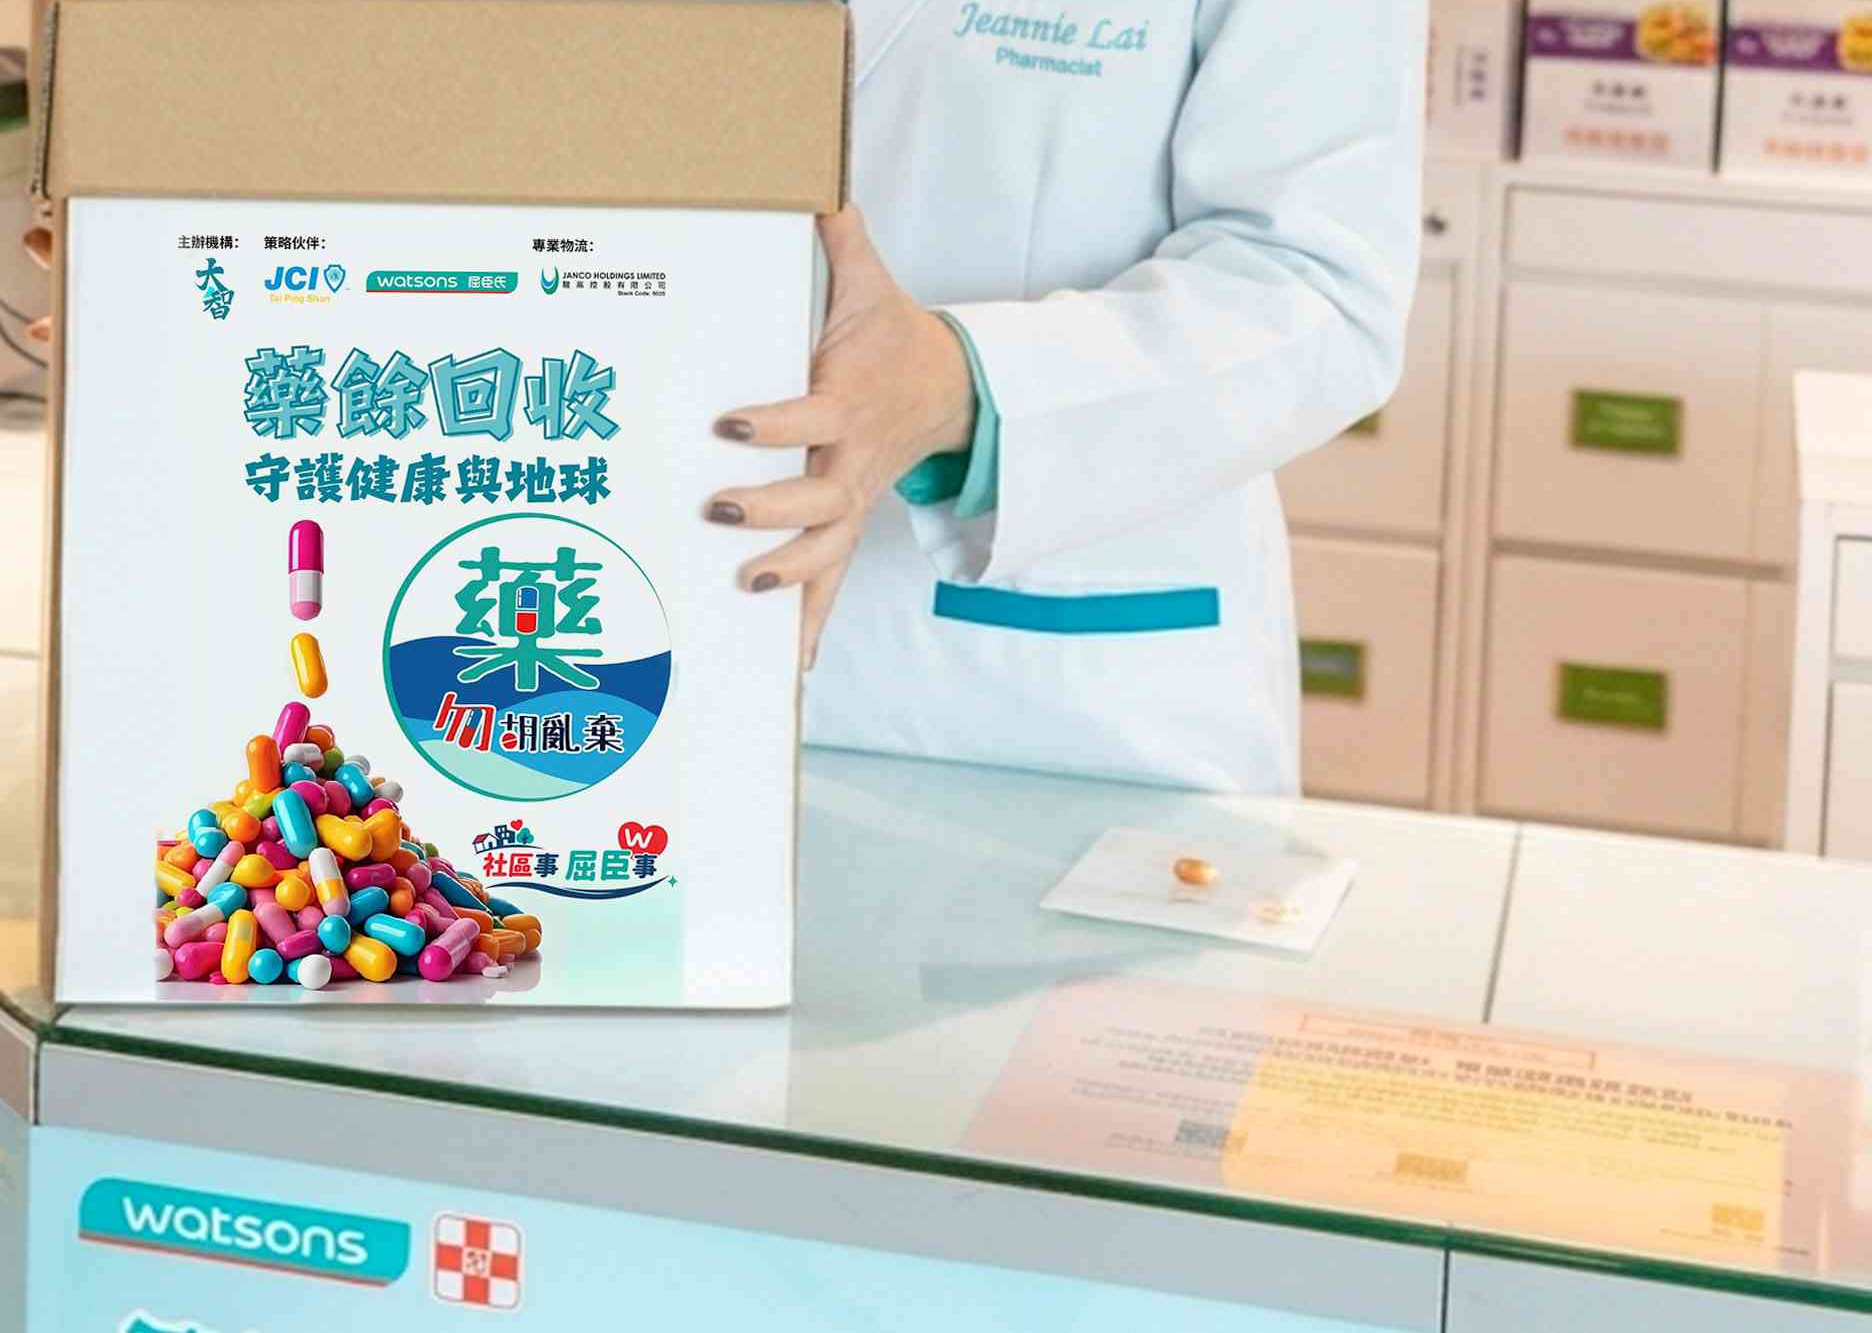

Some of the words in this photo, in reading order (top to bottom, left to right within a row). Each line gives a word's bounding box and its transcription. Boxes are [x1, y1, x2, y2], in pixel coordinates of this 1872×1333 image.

[953, 2, 1078, 46] Jeannie
[1085, 17, 1150, 51] Lai
[995, 46, 1104, 78] Pharmacist
[194, 257, 235, 321] 大智
[264, 266, 319, 291] JCI
[377, 275, 459, 288] watsons
[468, 275, 507, 289] 屈臣氏
[562, 271, 592, 281] JANCO
[593, 271, 635, 281] HOLDINGS
[636, 271, 666, 281] LIMITED
[268, 294, 282, 303] Tai
[284, 294, 305, 305] Ping
[306, 294, 331, 304] Shan
[243, 345, 621, 442] 藥餘回收
[244, 451, 612, 505] 守護健康與地球
[453, 546, 604, 691] 藥
[482, 852, 559, 878] 社區事
[565, 849, 658, 881] 屈臣事
[122, 1195, 369, 1266] watsons
